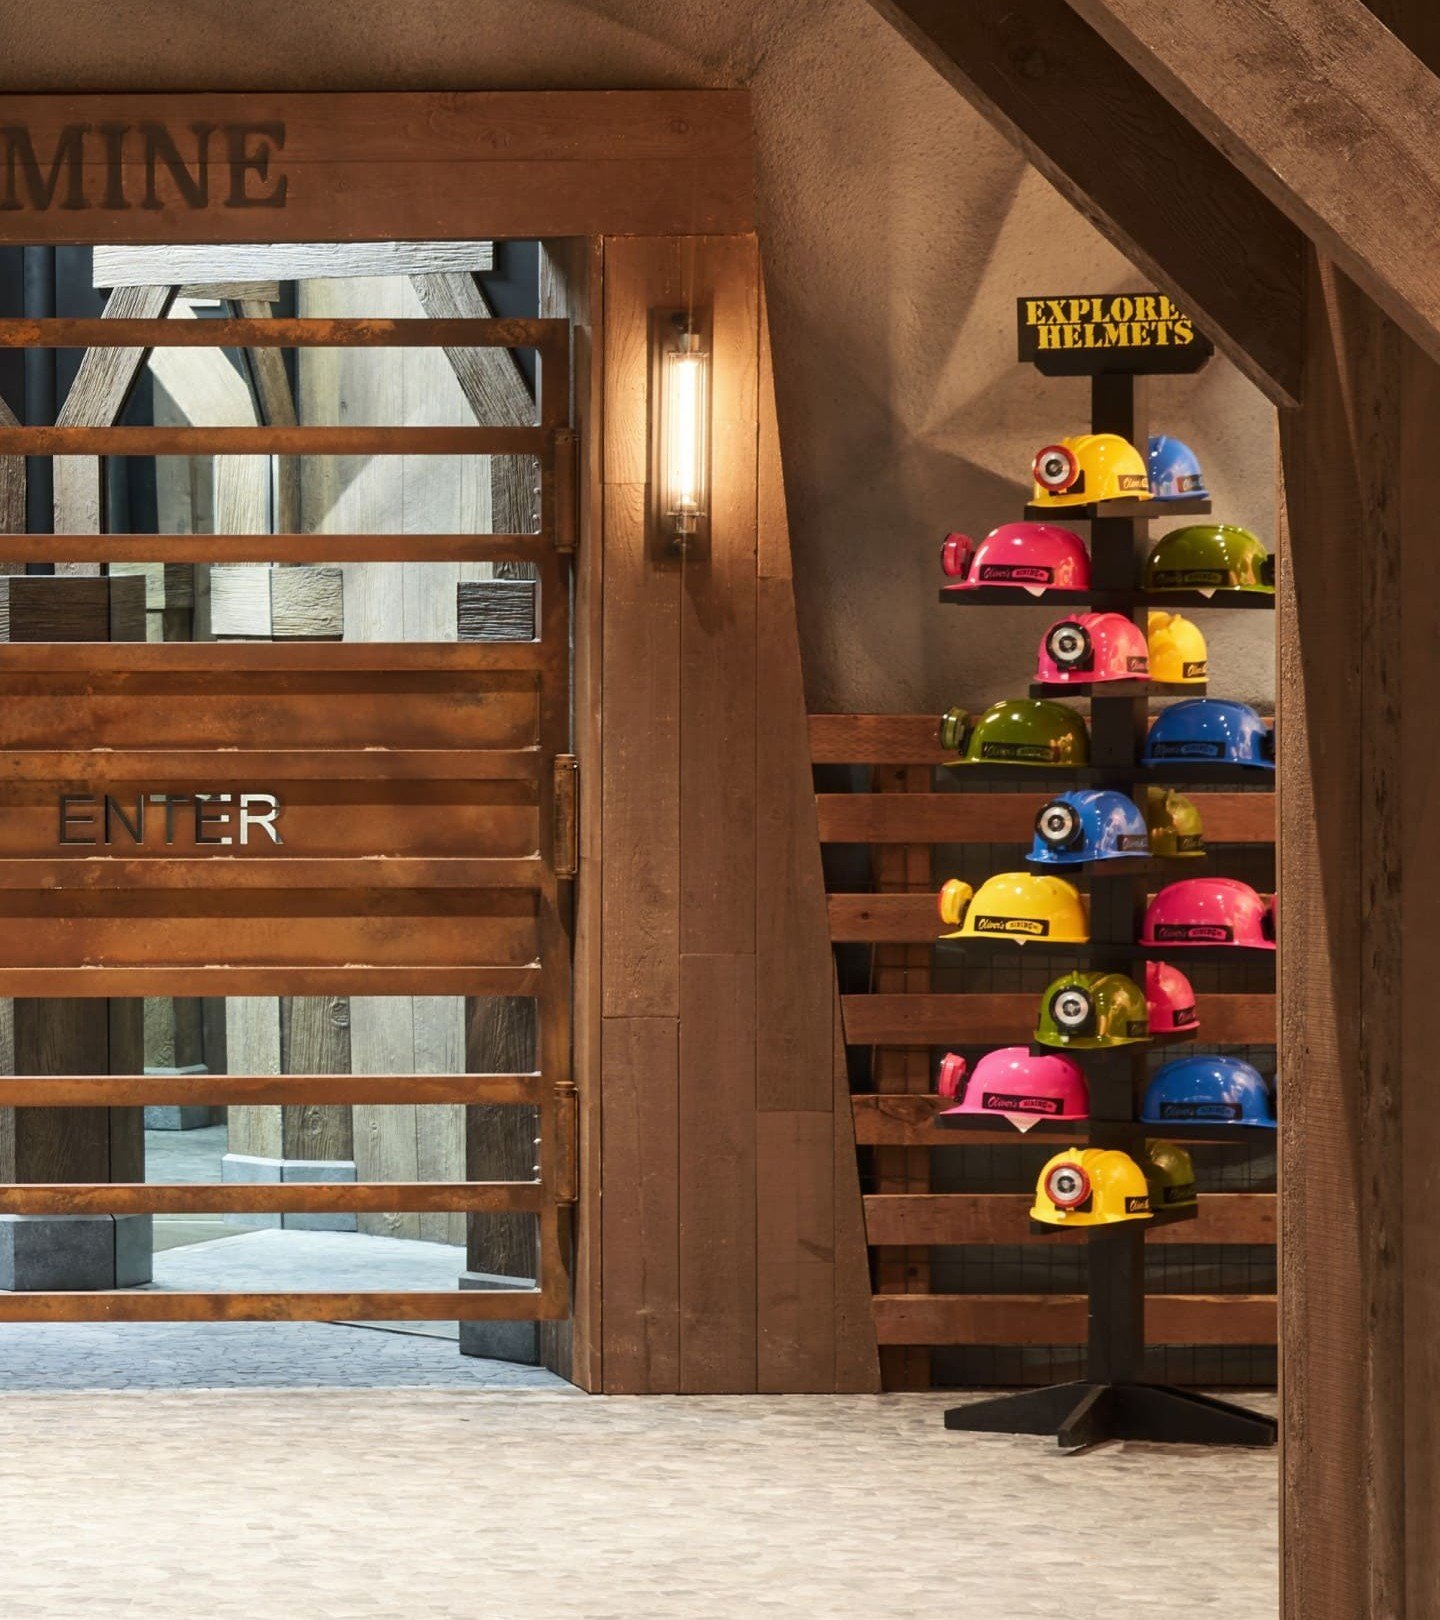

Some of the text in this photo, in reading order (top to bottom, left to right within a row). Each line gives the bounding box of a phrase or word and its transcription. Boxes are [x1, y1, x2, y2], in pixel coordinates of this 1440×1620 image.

[1026, 295, 1188, 325] EXPLORE
[1037, 319, 1194, 349] HELMETS
[60, 794, 284, 845] ENTER
